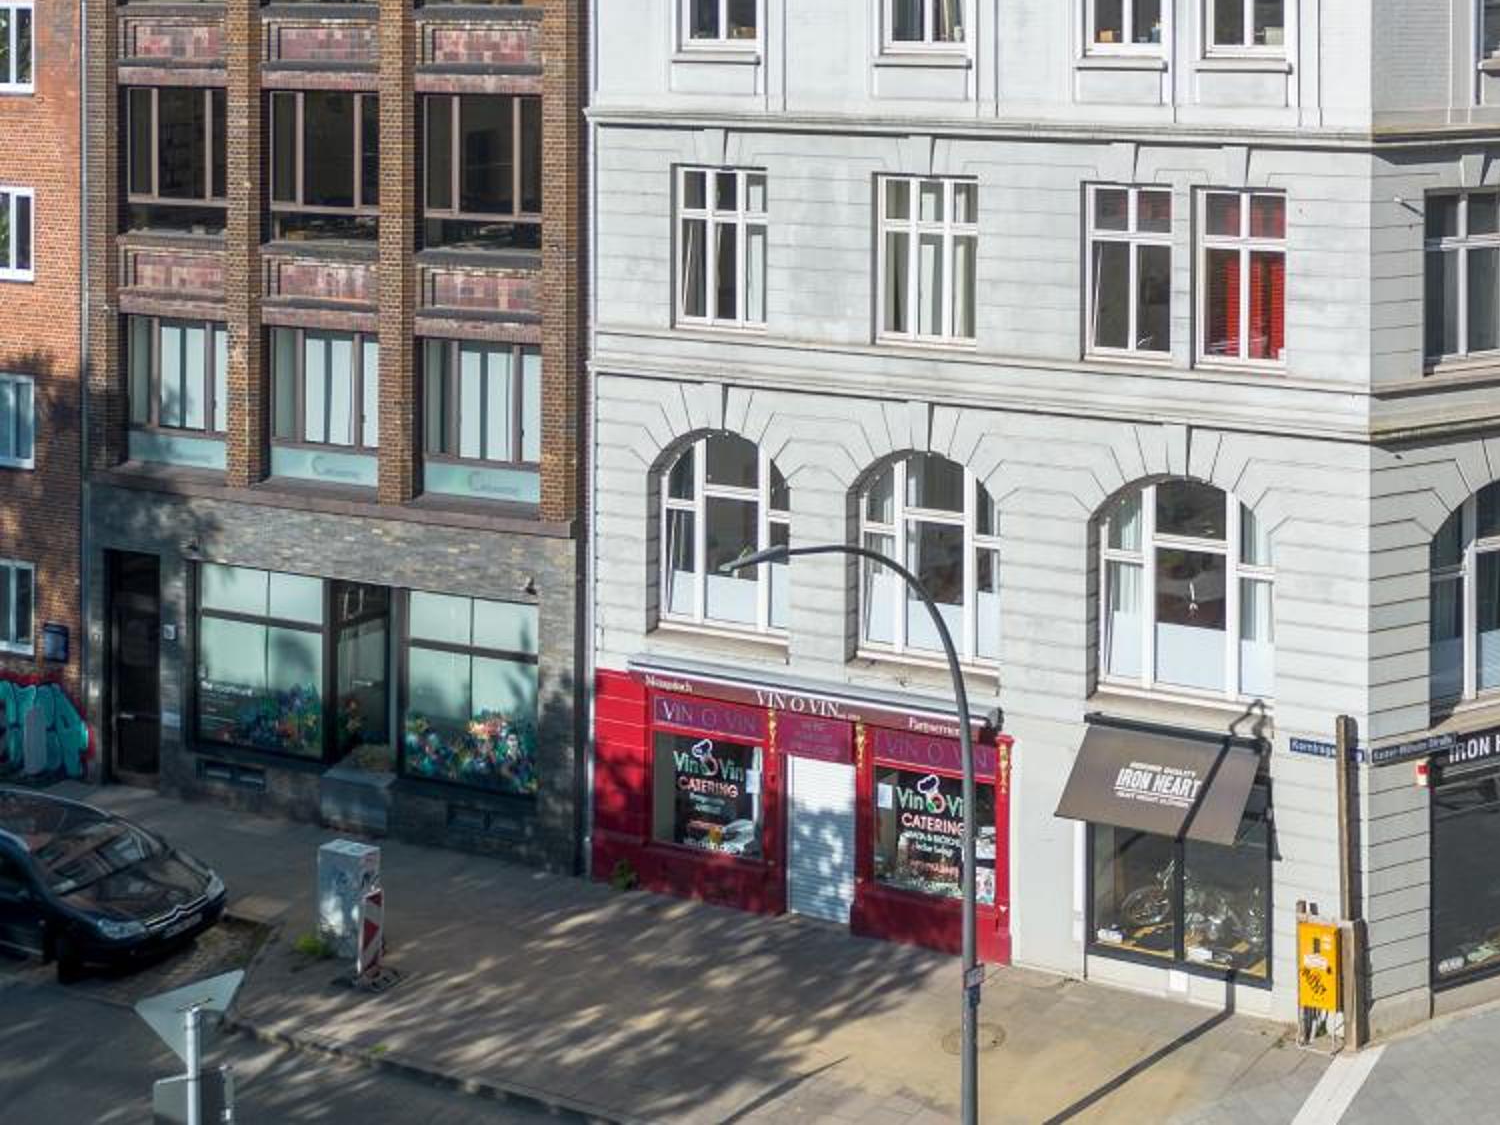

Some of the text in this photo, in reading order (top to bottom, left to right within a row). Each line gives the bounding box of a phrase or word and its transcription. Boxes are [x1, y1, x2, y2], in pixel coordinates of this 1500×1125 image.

[663, 700, 694, 724] VIN
[756, 690, 786, 711] VIN
[790, 697, 804, 712] O
[808, 700, 839, 718] VIN
[1448, 736, 1491, 764] IRON
[672, 750, 700, 775] Vin
[718, 758, 745, 783] Vin
[677, 775, 739, 799] CATERING
[1115, 767, 1152, 790] IRON
[1152, 773, 1203, 798] HEART
[896, 786, 924, 811] Vin
[945, 794, 965, 817] Vi
